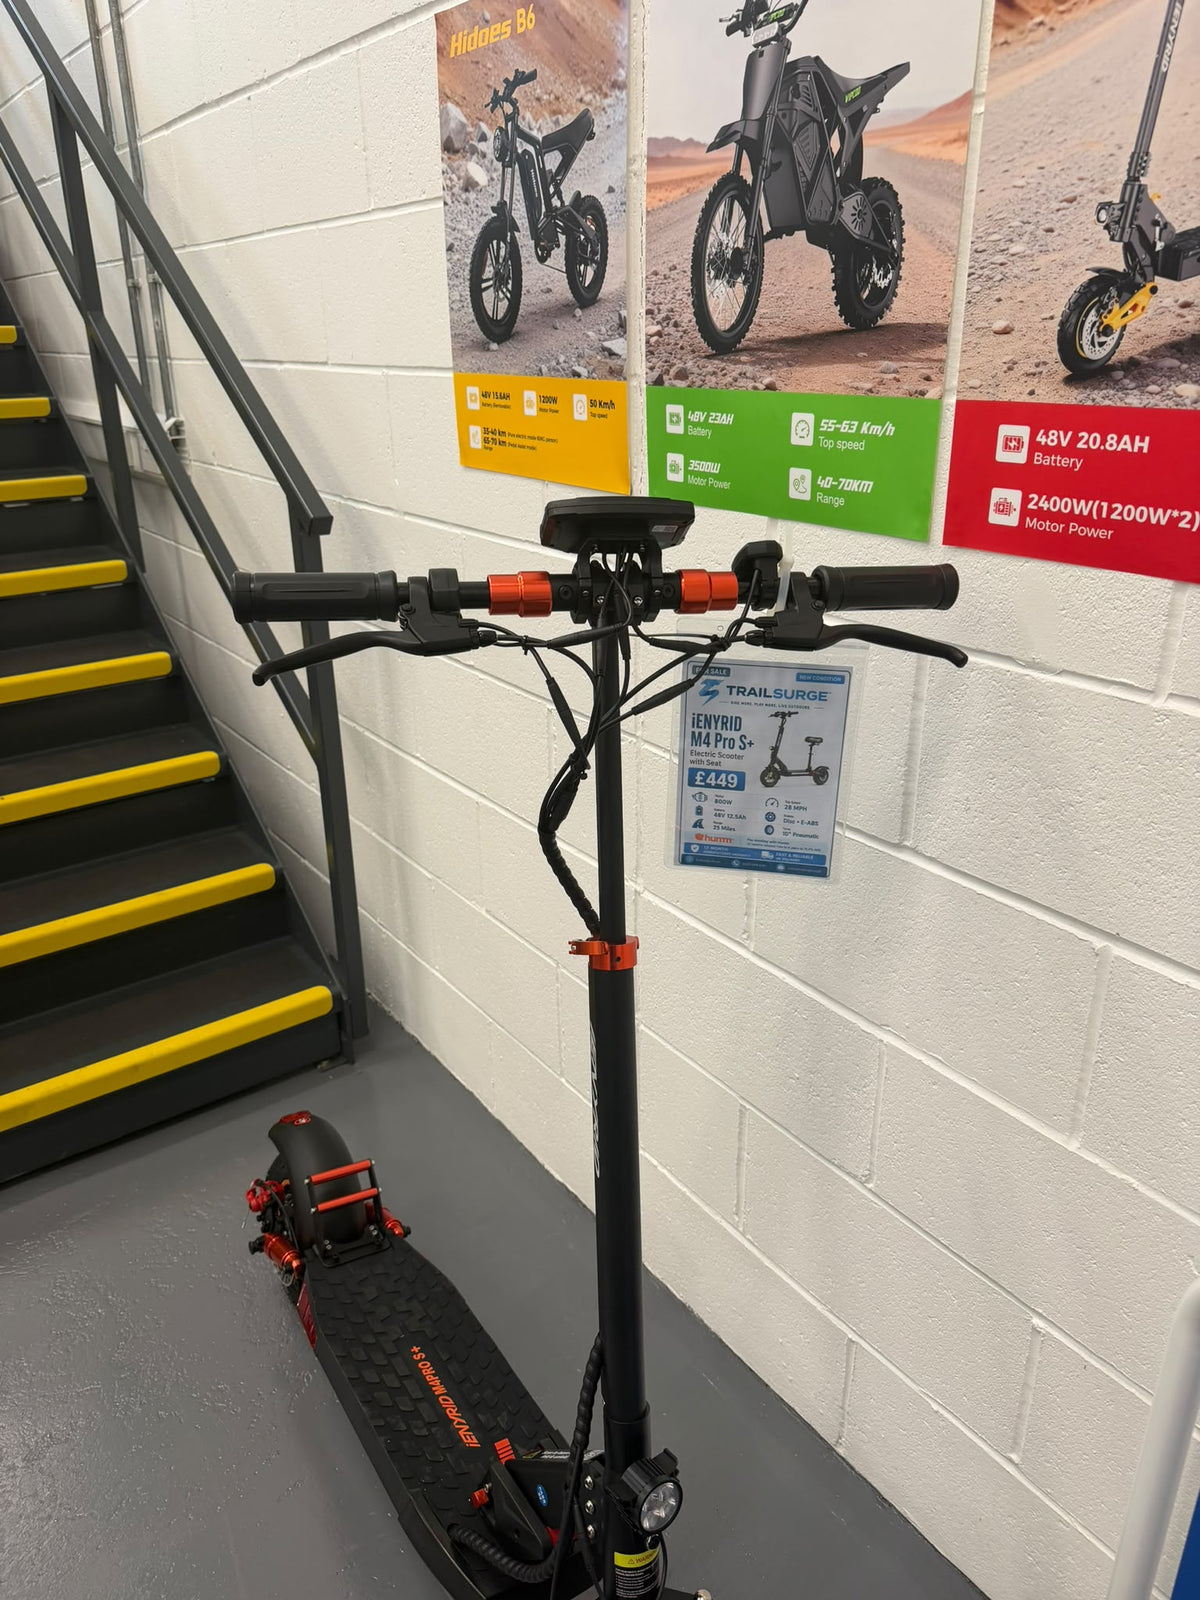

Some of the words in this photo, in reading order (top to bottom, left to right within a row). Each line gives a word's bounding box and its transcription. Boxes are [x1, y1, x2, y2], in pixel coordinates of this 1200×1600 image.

[449, 19, 512, 58] Hidoes
[516, 3, 535, 34] B6
[538, 395, 558, 404] 1200W
[589, 399, 598, 408] 50
[598, 399, 616, 410] Km/h
[688, 410, 706, 423] 48V
[708, 412, 734, 425] 23AH
[688, 426, 712, 439] Battery
[819, 419, 857, 433] 55-63
[860, 421, 895, 436] Km/h
[818, 436, 835, 449] Top
[836, 438, 865, 451] speed
[1035, 429, 1072, 447] 48V
[1076, 432, 1150, 453] 20.8AH
[688, 460, 720, 474] 3500W
[1033, 452, 1084, 471] Battery
[688, 474, 708, 486] Motor
[708, 477, 731, 490] Power
[816, 493, 845, 506] Range
[1025, 517, 1065, 533] Motor
[1068, 523, 1114, 540] Power
[695, 667, 711, 675] FR
[726, 685, 829, 701] TRAILSURGE
[691, 713, 742, 731] iENYRID
[690, 731, 711, 748] M4
[714, 732, 736, 750] Pro
[738, 734, 754, 750] S+
[690, 749, 716, 758] Electric
[717, 751, 744, 760] Scooter
[706, 759, 721, 767] Seat
[695, 771, 738, 788] £449
[411, 1345, 426, 1360] S+
[417, 1361, 447, 1395] M4PRO
[438, 1395, 481, 1447] iENYRID
